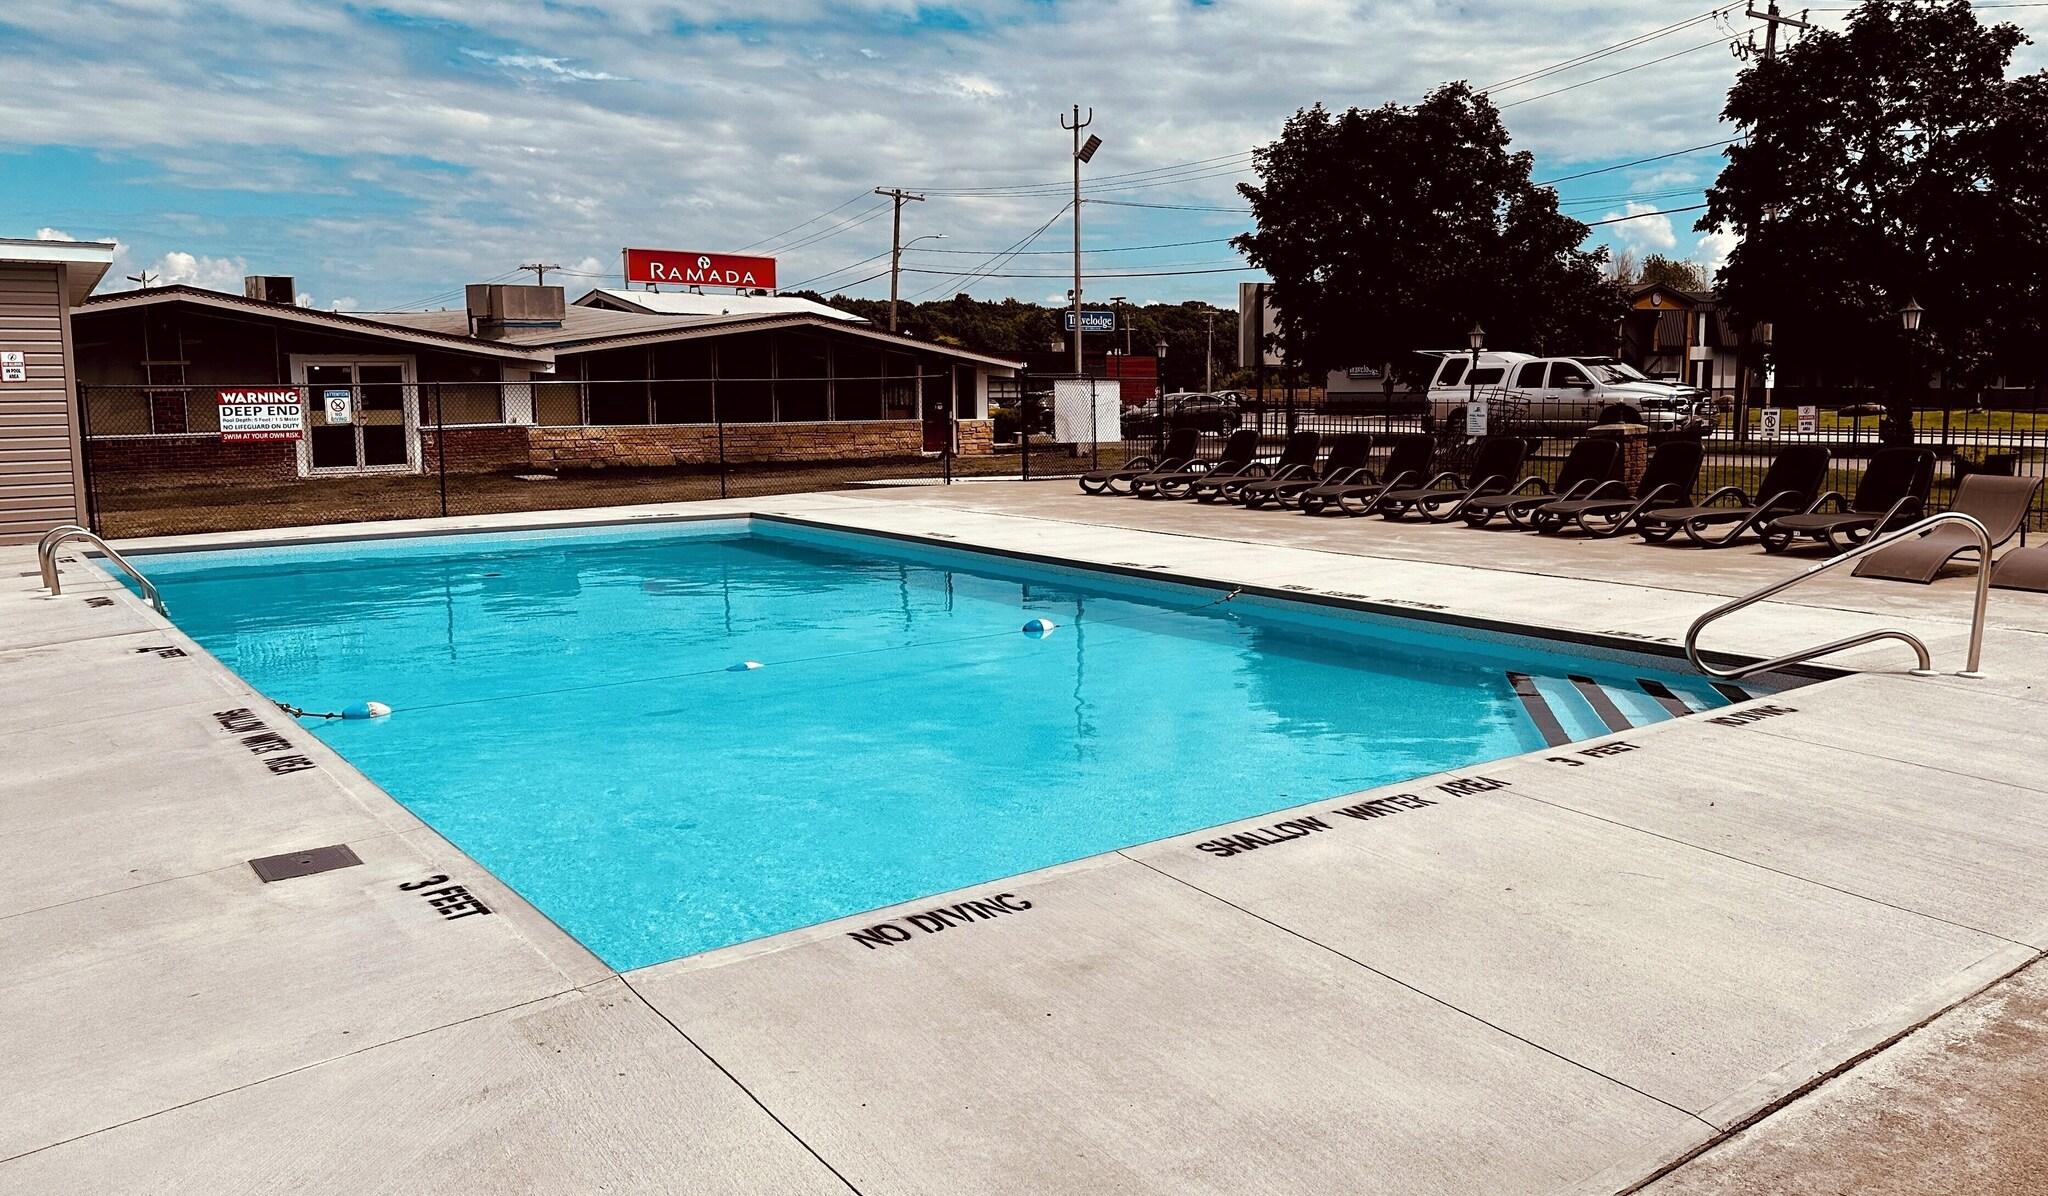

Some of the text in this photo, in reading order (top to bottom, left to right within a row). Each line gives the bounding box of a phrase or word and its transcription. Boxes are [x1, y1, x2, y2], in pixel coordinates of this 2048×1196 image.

[650, 262, 756, 285] RAMADA
[1067, 314, 1113, 329] Trvelodge
[221, 391, 298, 404] WARNING
[222, 406, 299, 417] DEEP END
[1545, 741, 1641, 767] 3 FEET
[1195, 775, 1512, 858] SHALLOW WATER AREA
[398, 874, 493, 921] 3 FEET
[846, 893, 1033, 950] NO DIVING
